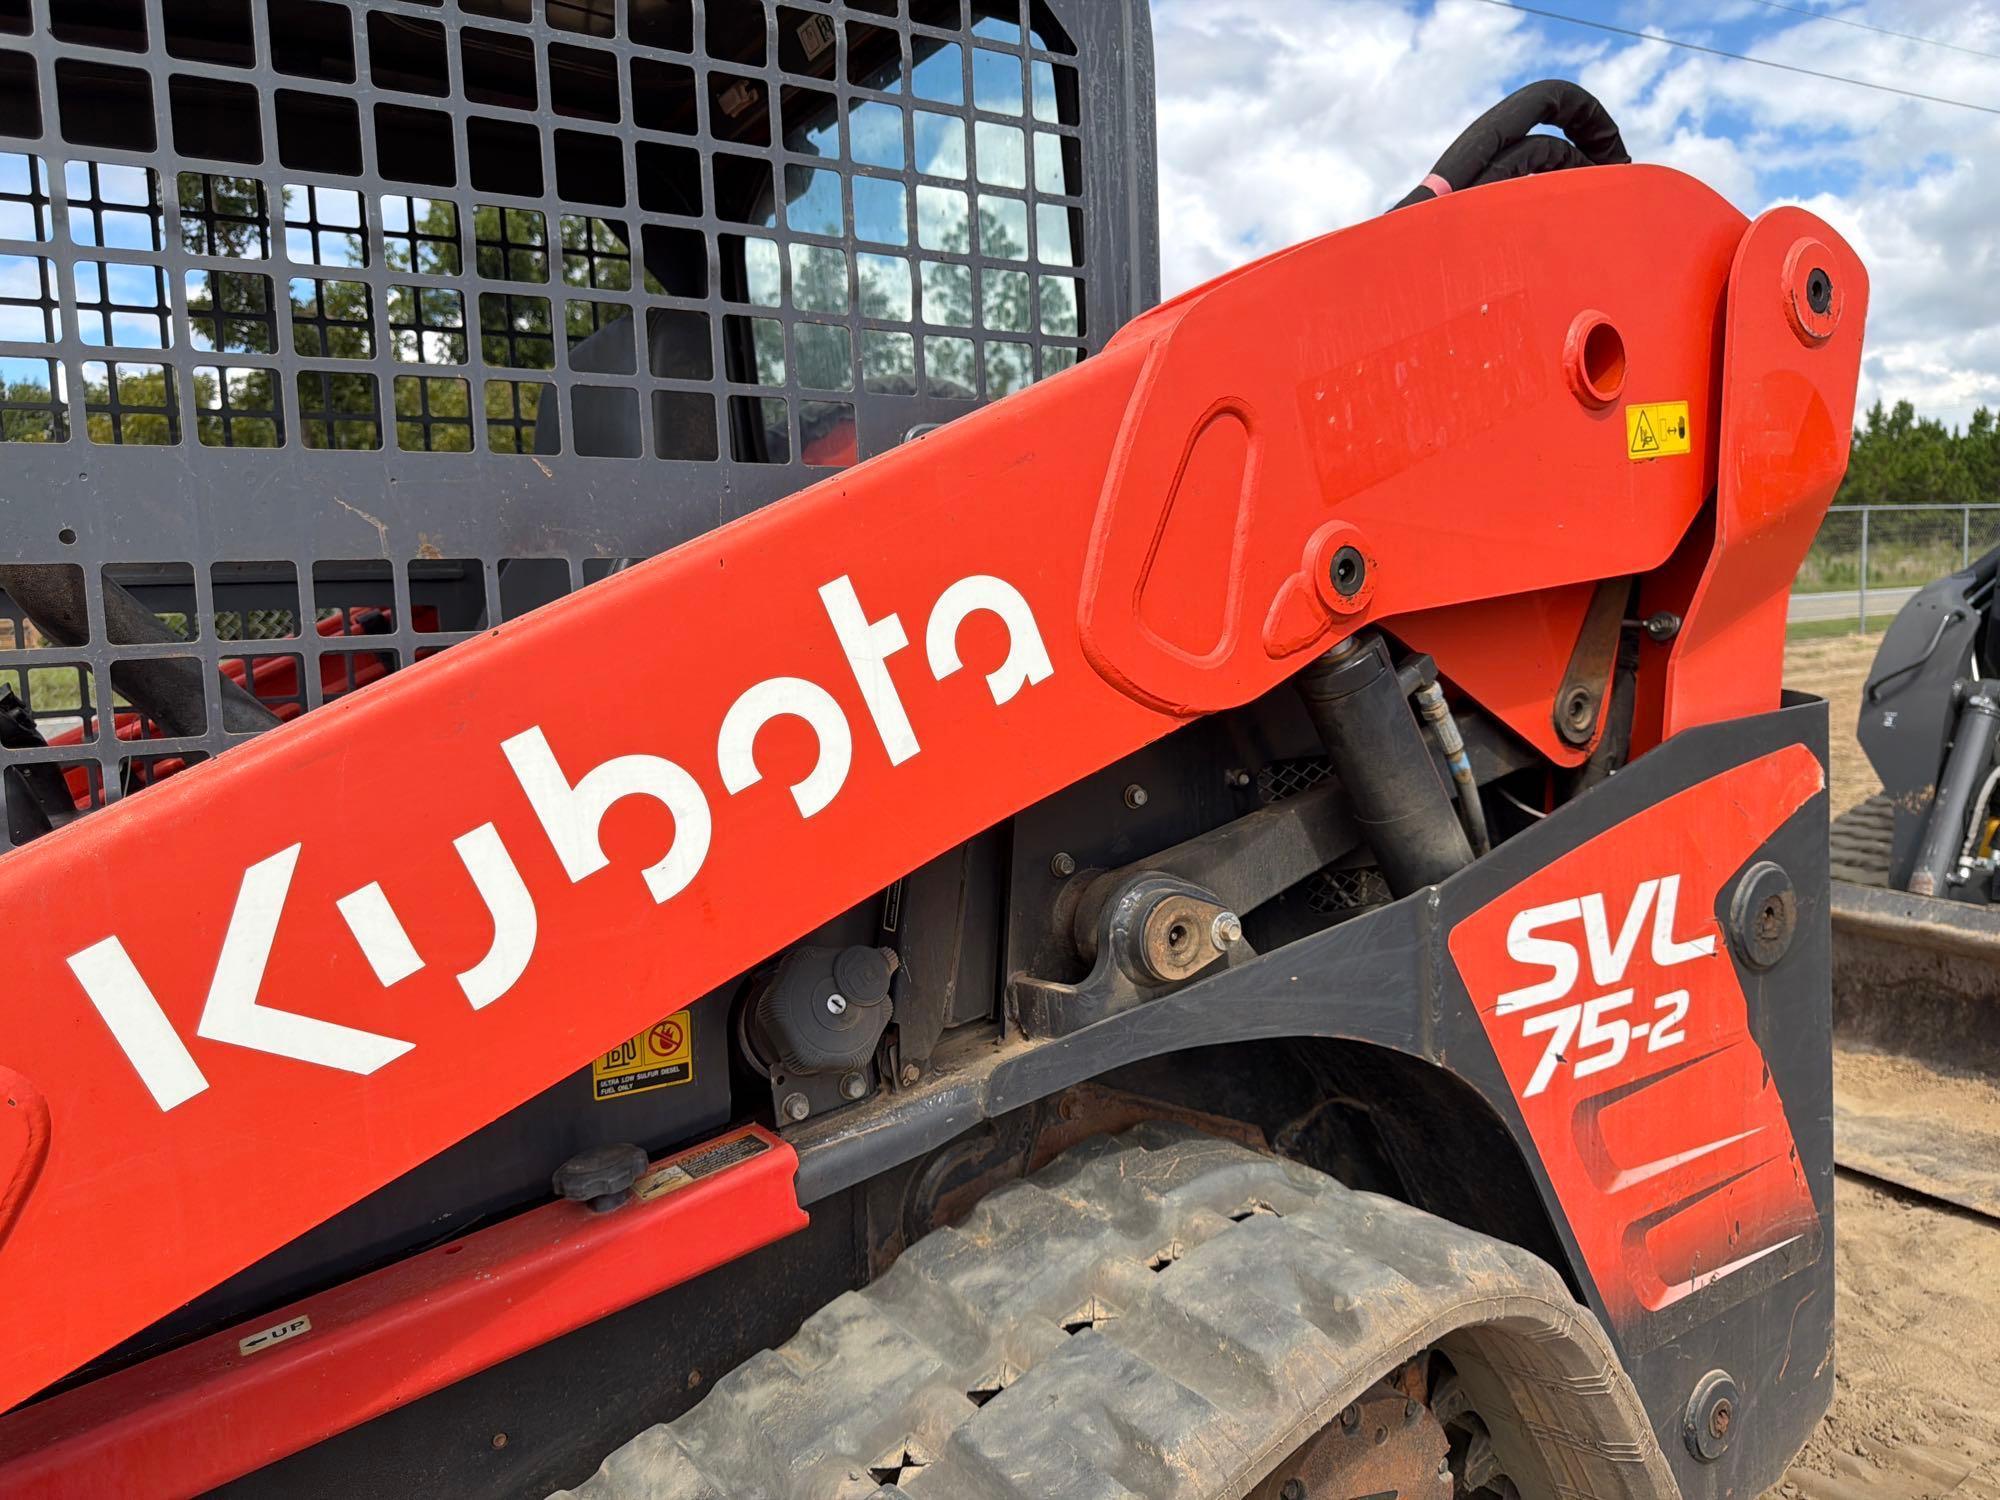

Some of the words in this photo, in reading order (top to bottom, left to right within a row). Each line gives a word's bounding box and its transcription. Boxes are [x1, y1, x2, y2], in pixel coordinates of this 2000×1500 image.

[67, 575, 1053, 1111] Kubota
[1496, 875, 1716, 1015] SVL
[1522, 989, 1690, 1098] 75-2
[600, 1079, 620, 1087] ULTRA
[621, 1075, 635, 1083] LOW
[636, 1070, 659, 1079] SULFUR
[661, 1066, 680, 1075] DIESEL
[600, 1087, 616, 1095] FUEL
[618, 1084, 633, 1092] ONLY
[272, 1320, 304, 1338] UP
